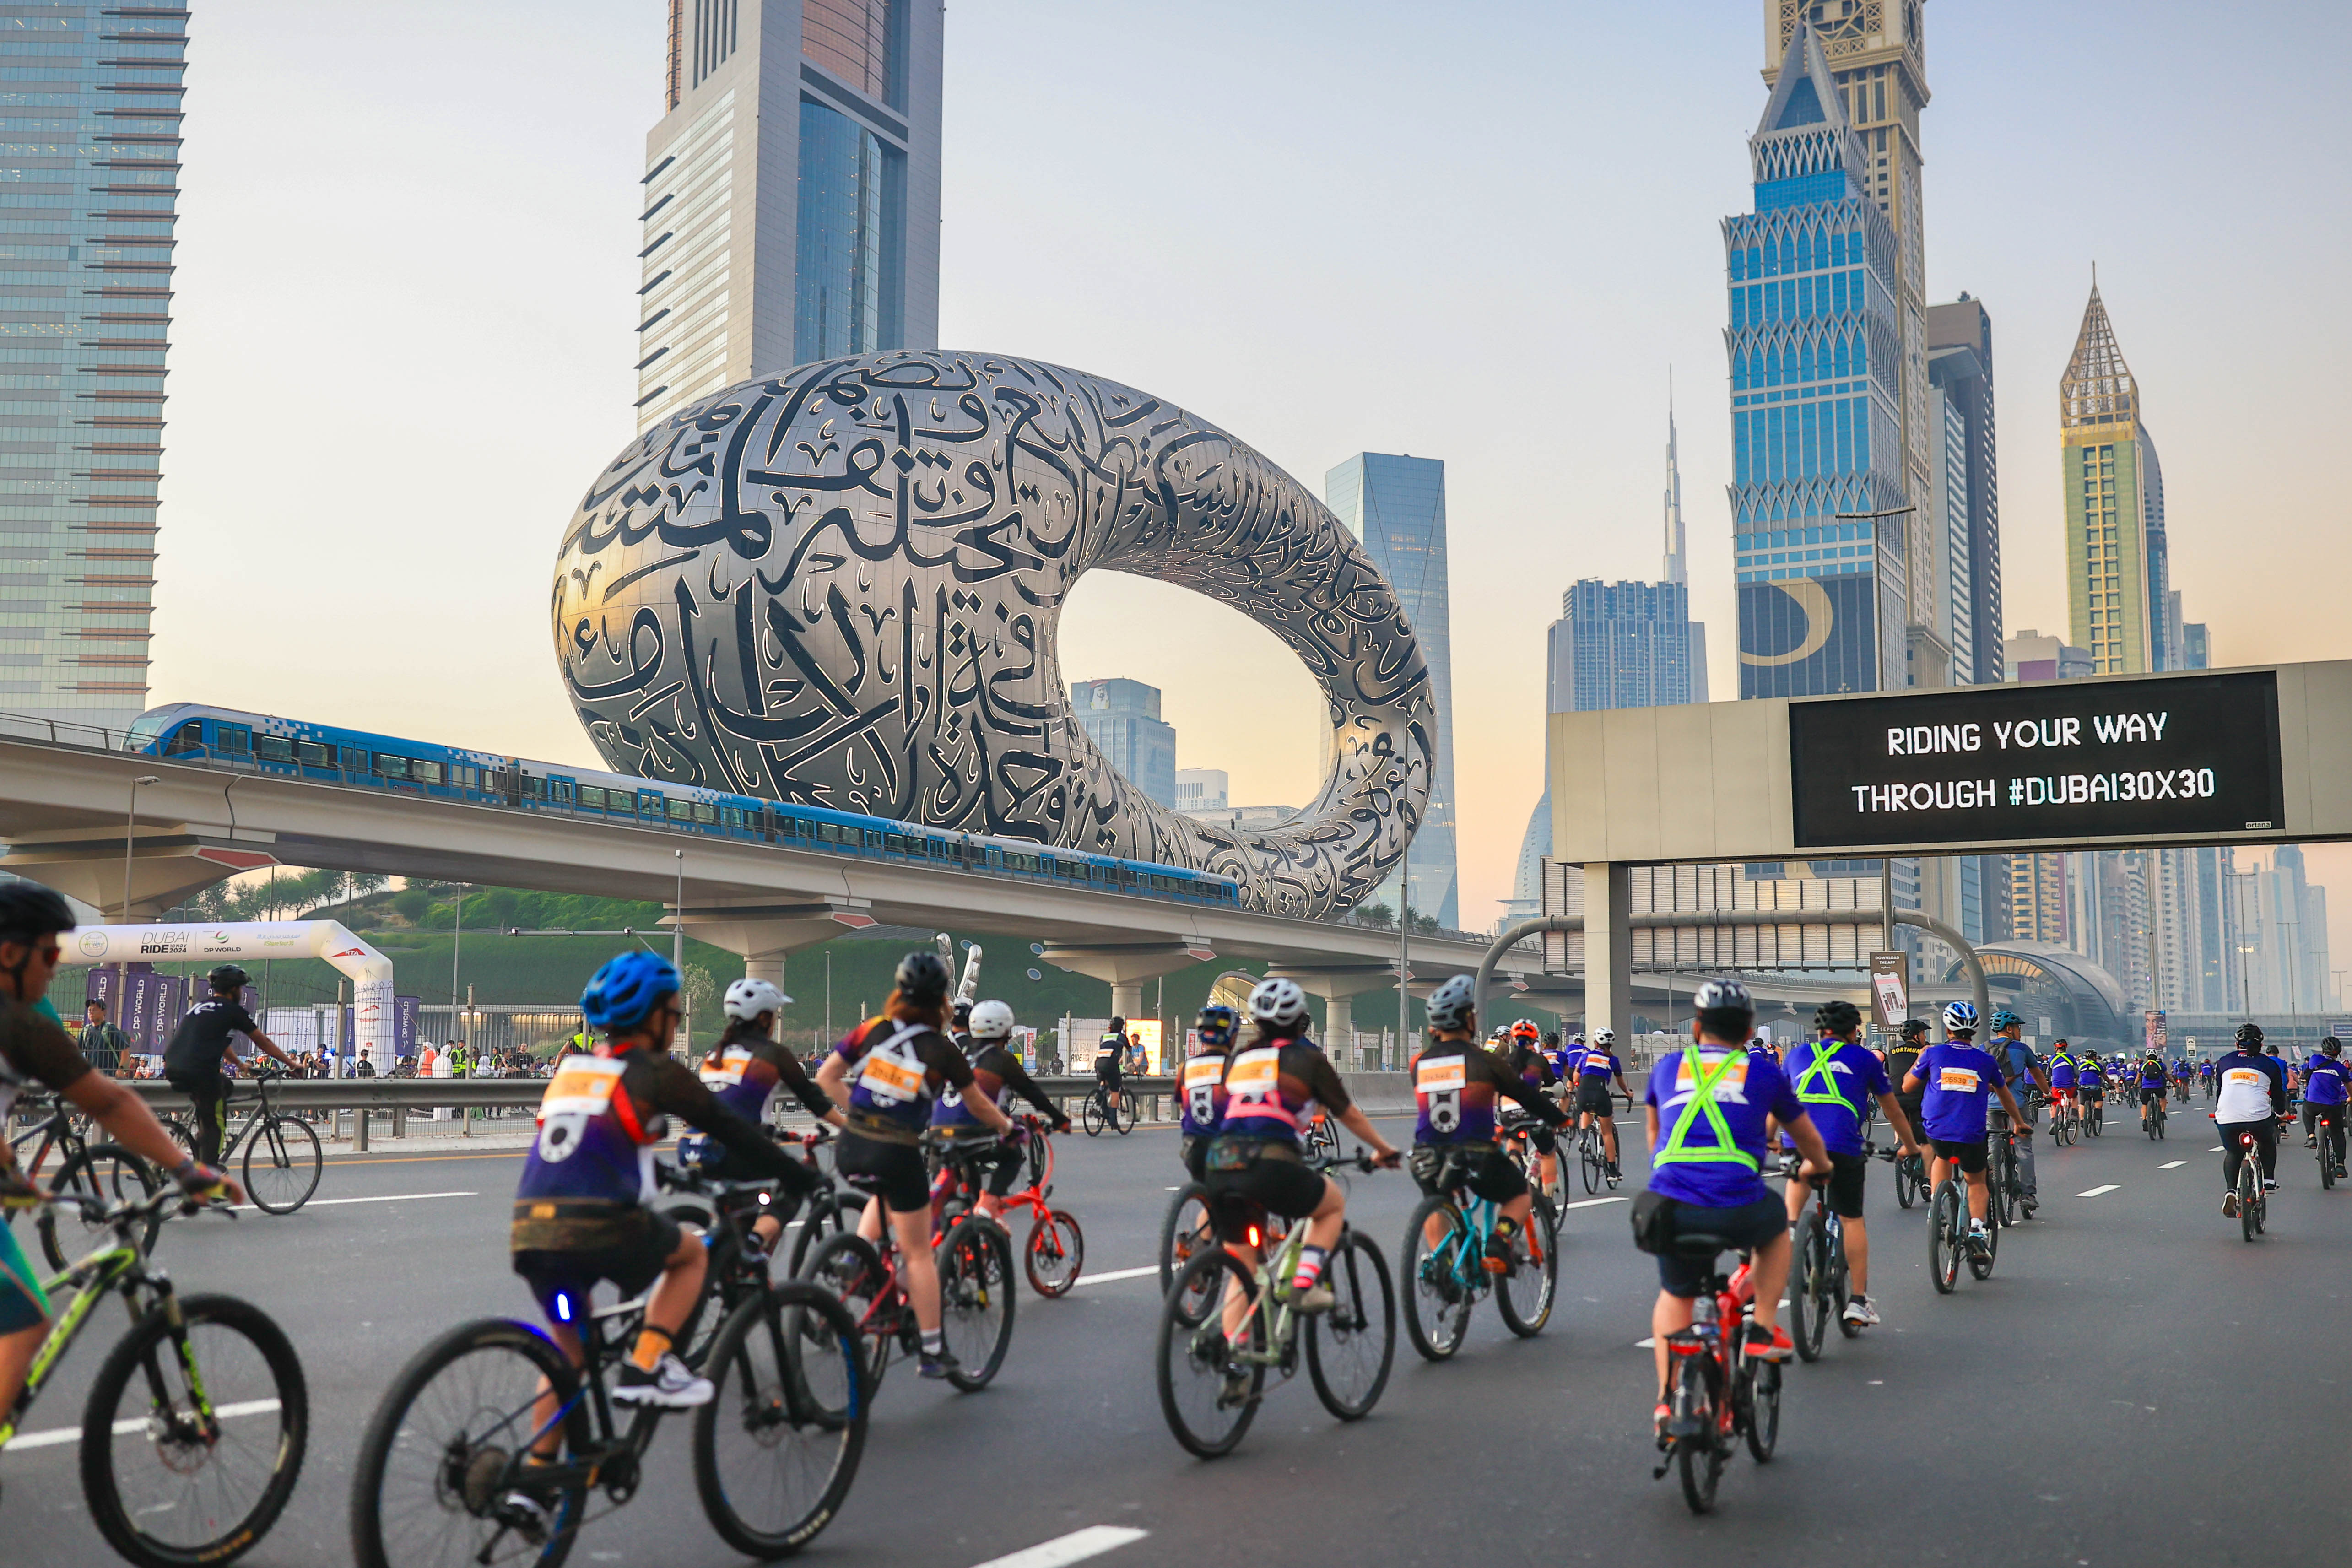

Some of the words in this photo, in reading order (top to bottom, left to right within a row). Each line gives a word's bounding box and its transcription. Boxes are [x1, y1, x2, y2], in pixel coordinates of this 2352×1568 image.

[1887, 723, 1981, 756] RIDING
[1993, 718, 2081, 750] YOUR
[2093, 711, 2168, 744] WAY
[1851, 779, 1996, 813] THROUGH
[2008, 768, 2215, 806] #DUBAI30X30
[141, 931, 190, 944] DUBAI
[141, 945, 168, 953] RIDE
[135, 979, 145, 1015] WORLD
[158, 983, 167, 1016] WORLD
[133, 1015, 141, 1029] DP
[157, 1017, 164, 1031] DP
